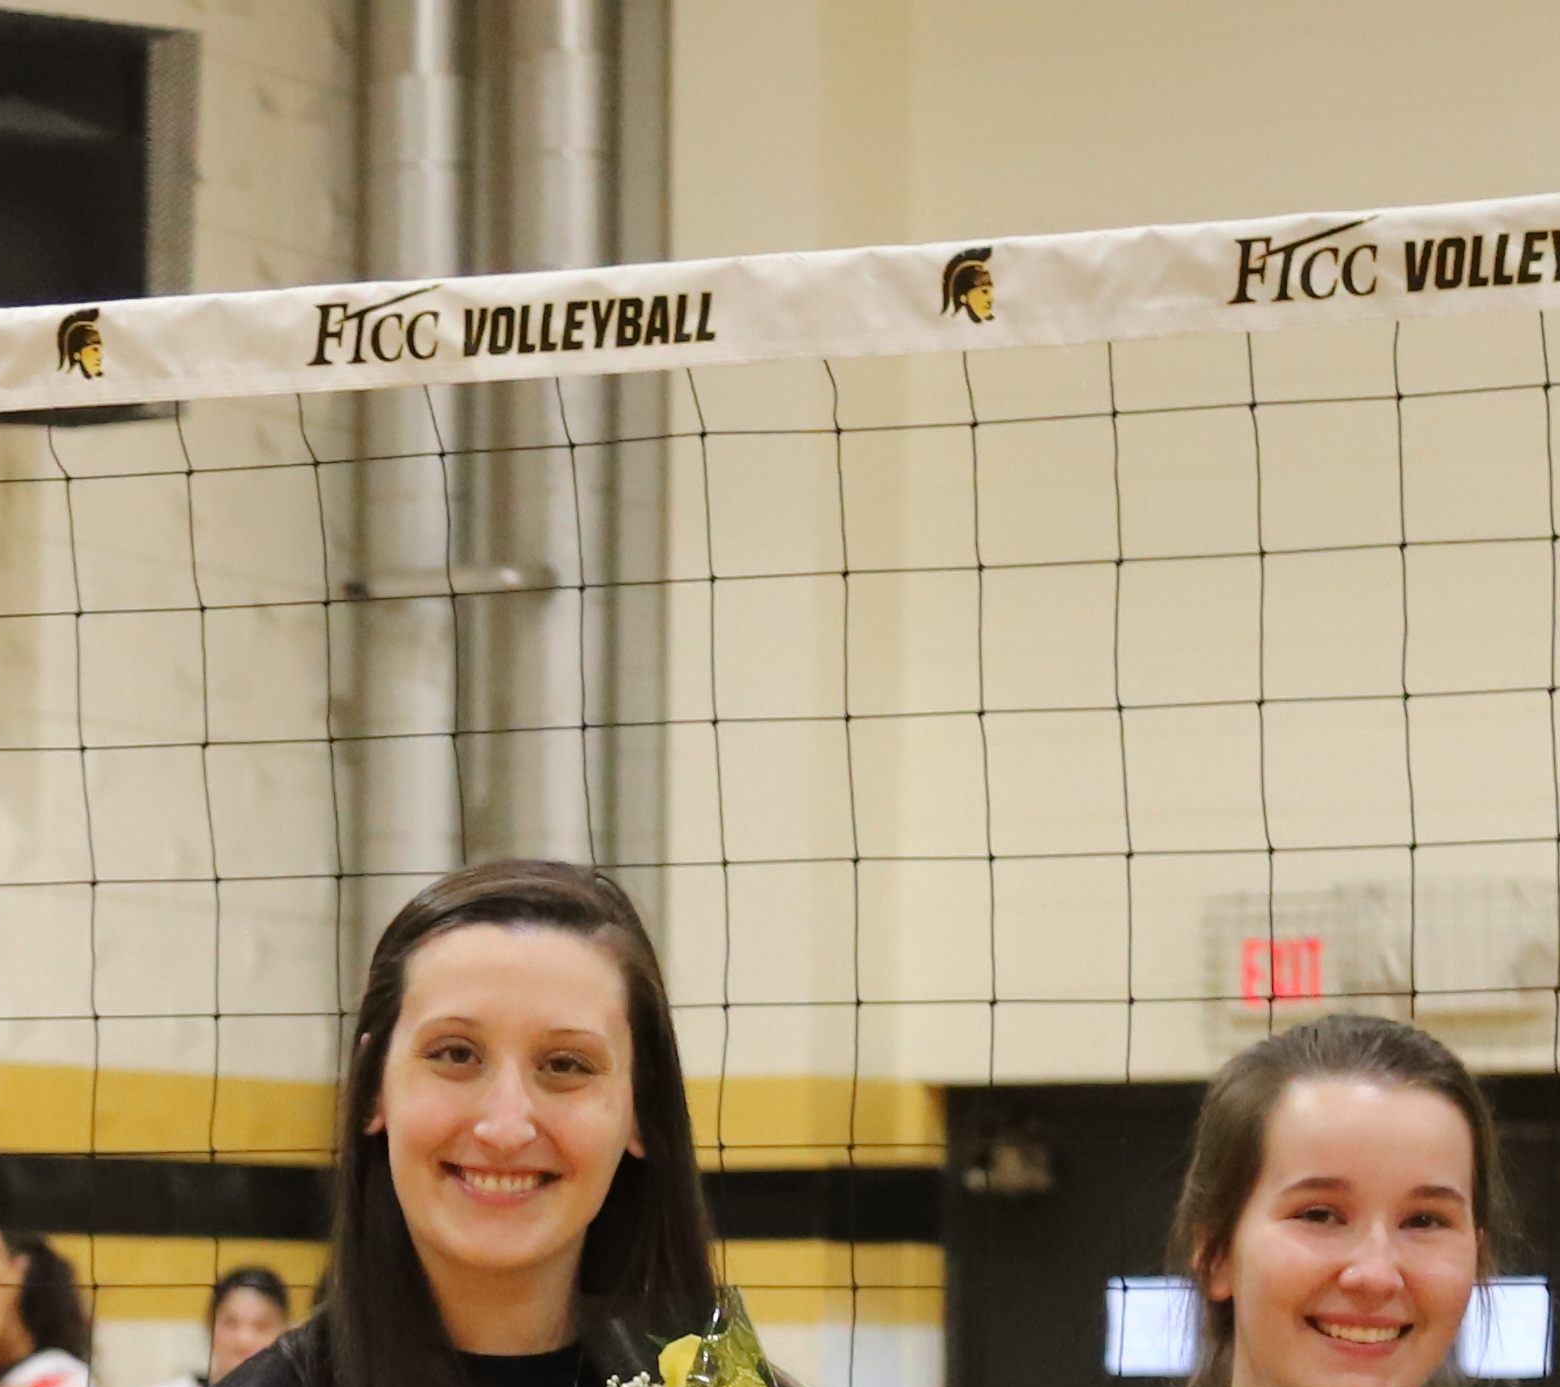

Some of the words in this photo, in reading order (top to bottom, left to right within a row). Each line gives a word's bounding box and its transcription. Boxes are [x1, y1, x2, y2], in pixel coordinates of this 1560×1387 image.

[1228, 215, 1379, 304] FTCC
[310, 286, 441, 367] FTCC
[461, 291, 716, 357] VOLLEYBALL
[1242, 938, 1323, 1006] EXIT
